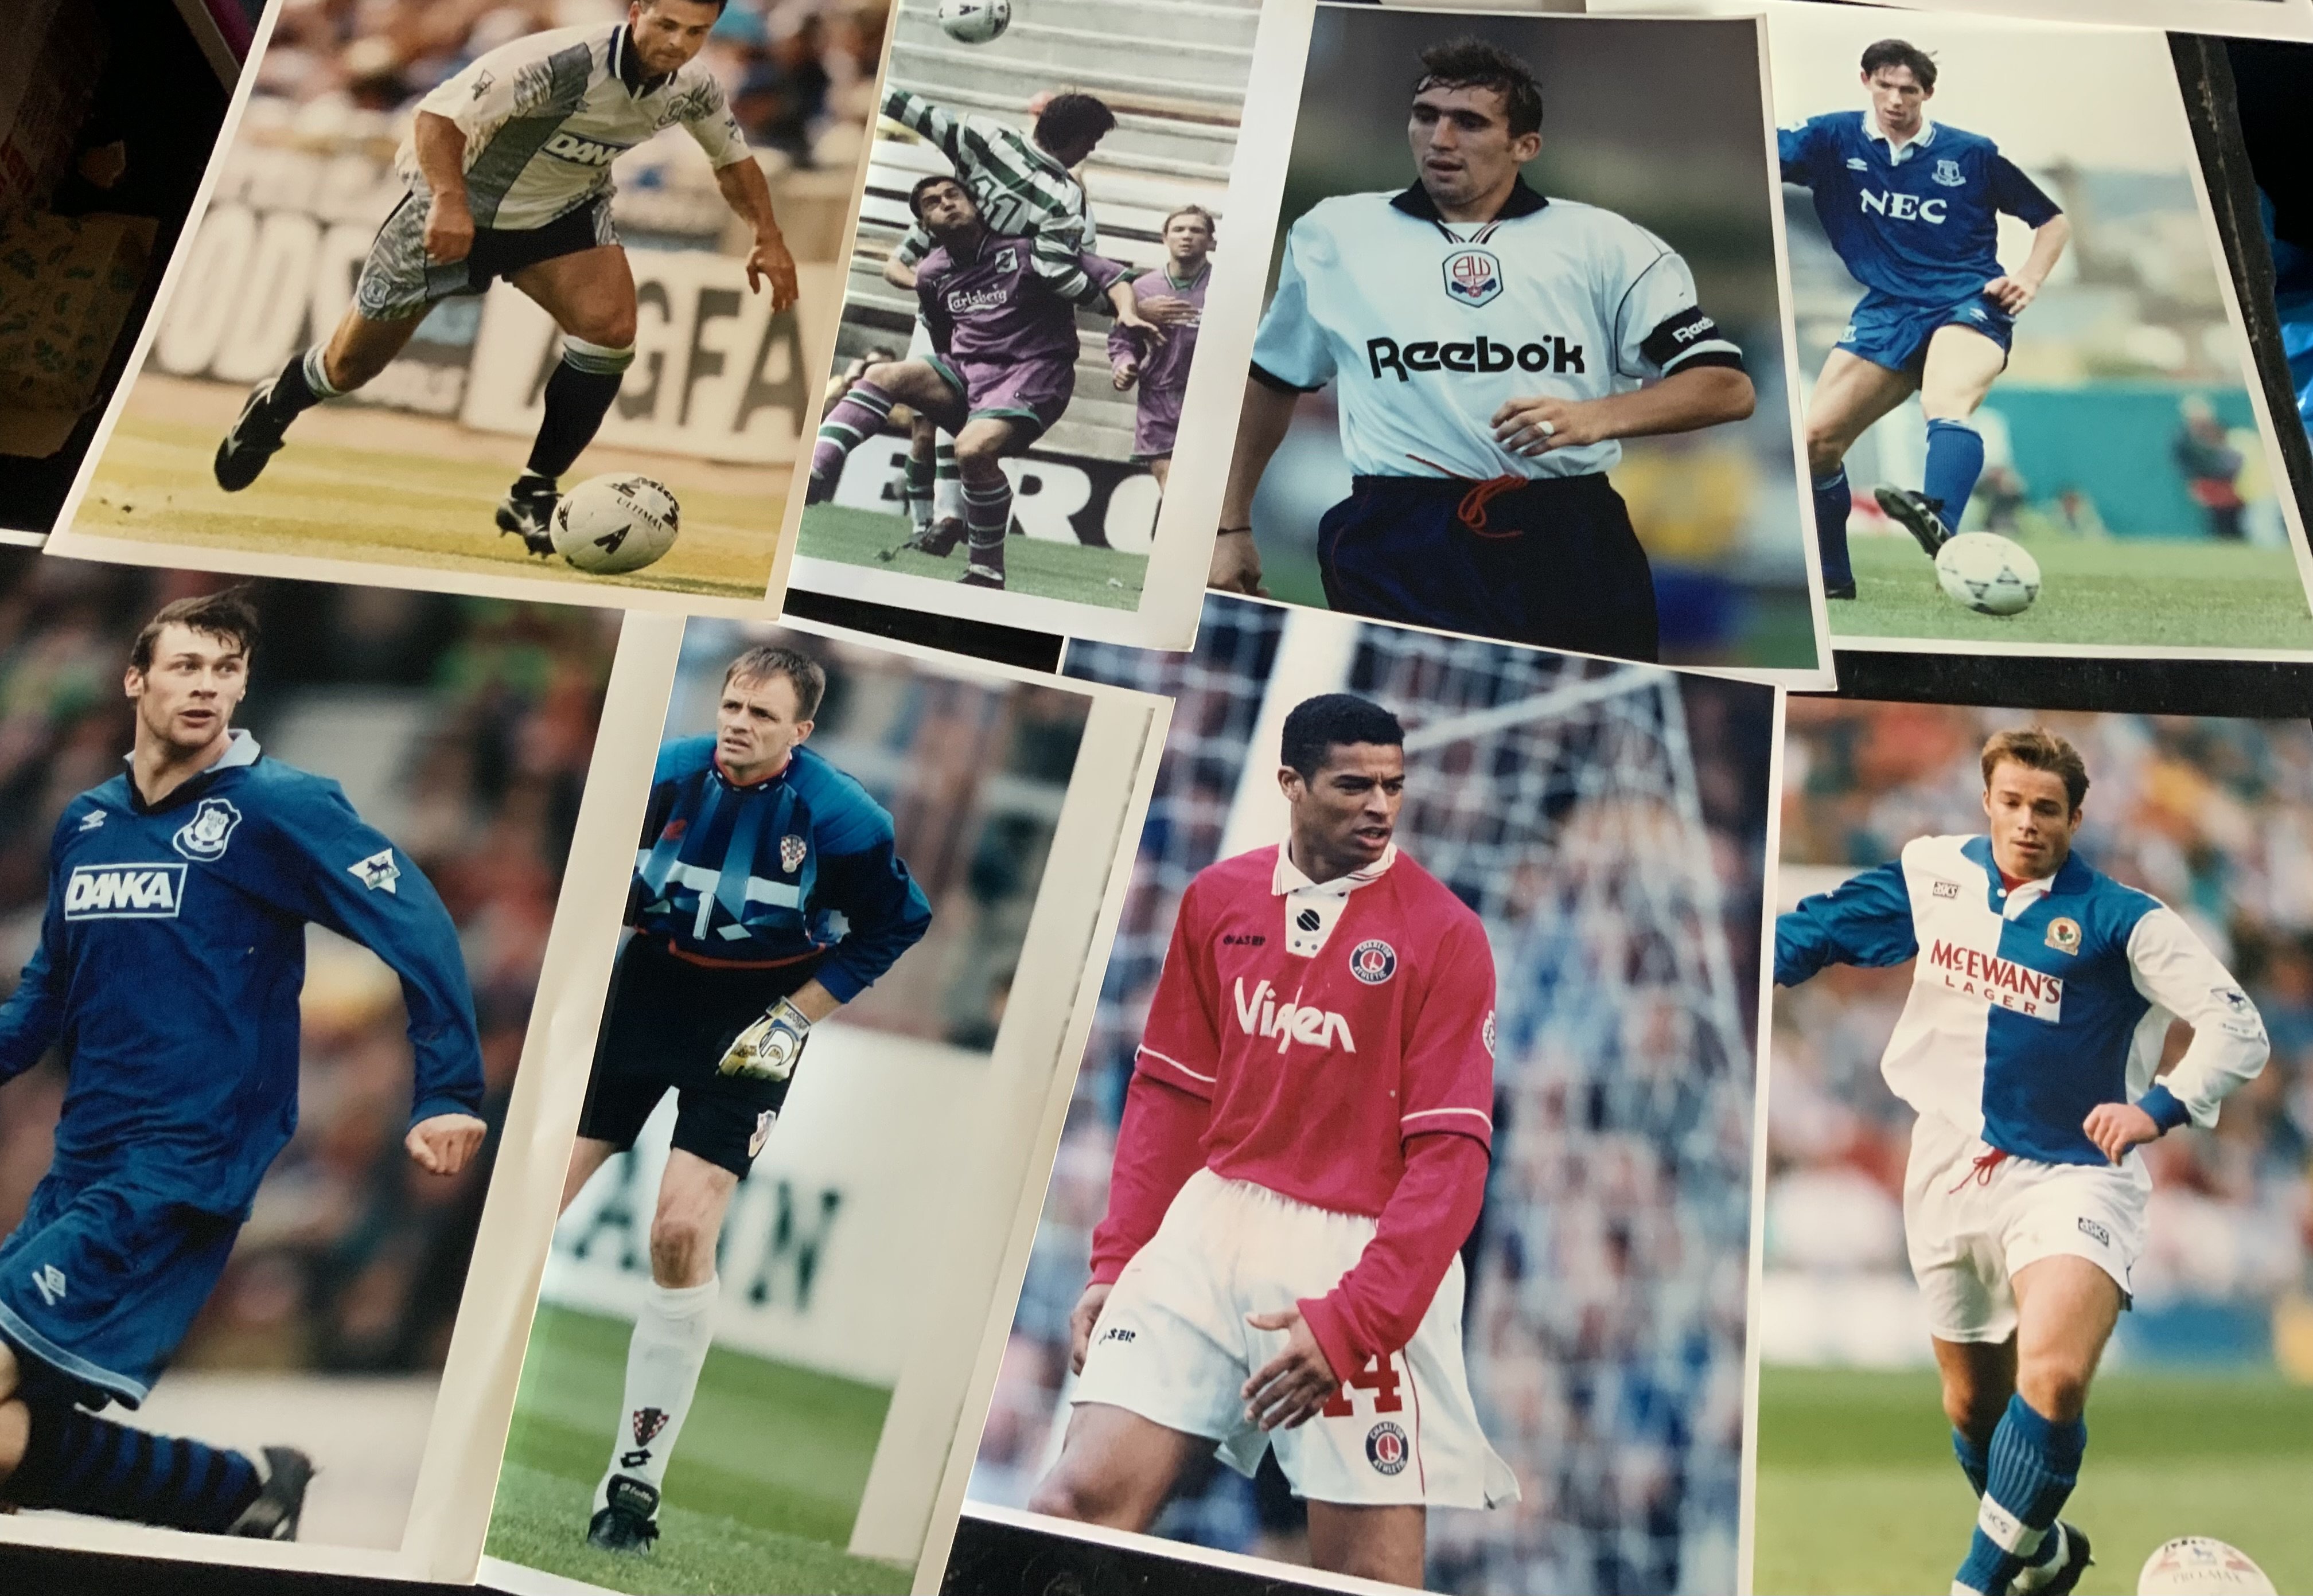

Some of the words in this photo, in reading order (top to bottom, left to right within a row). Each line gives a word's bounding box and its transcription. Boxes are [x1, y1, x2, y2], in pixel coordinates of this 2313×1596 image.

[1860, 188, 1948, 224] NEC
[947, 286, 1008, 313] Carlsberg
[523, 279, 812, 438] GFA
[1366, 335, 1585, 383] Reebok
[67, 872, 175, 911] DANKA
[1945, 974, 2036, 1015] LAGER
